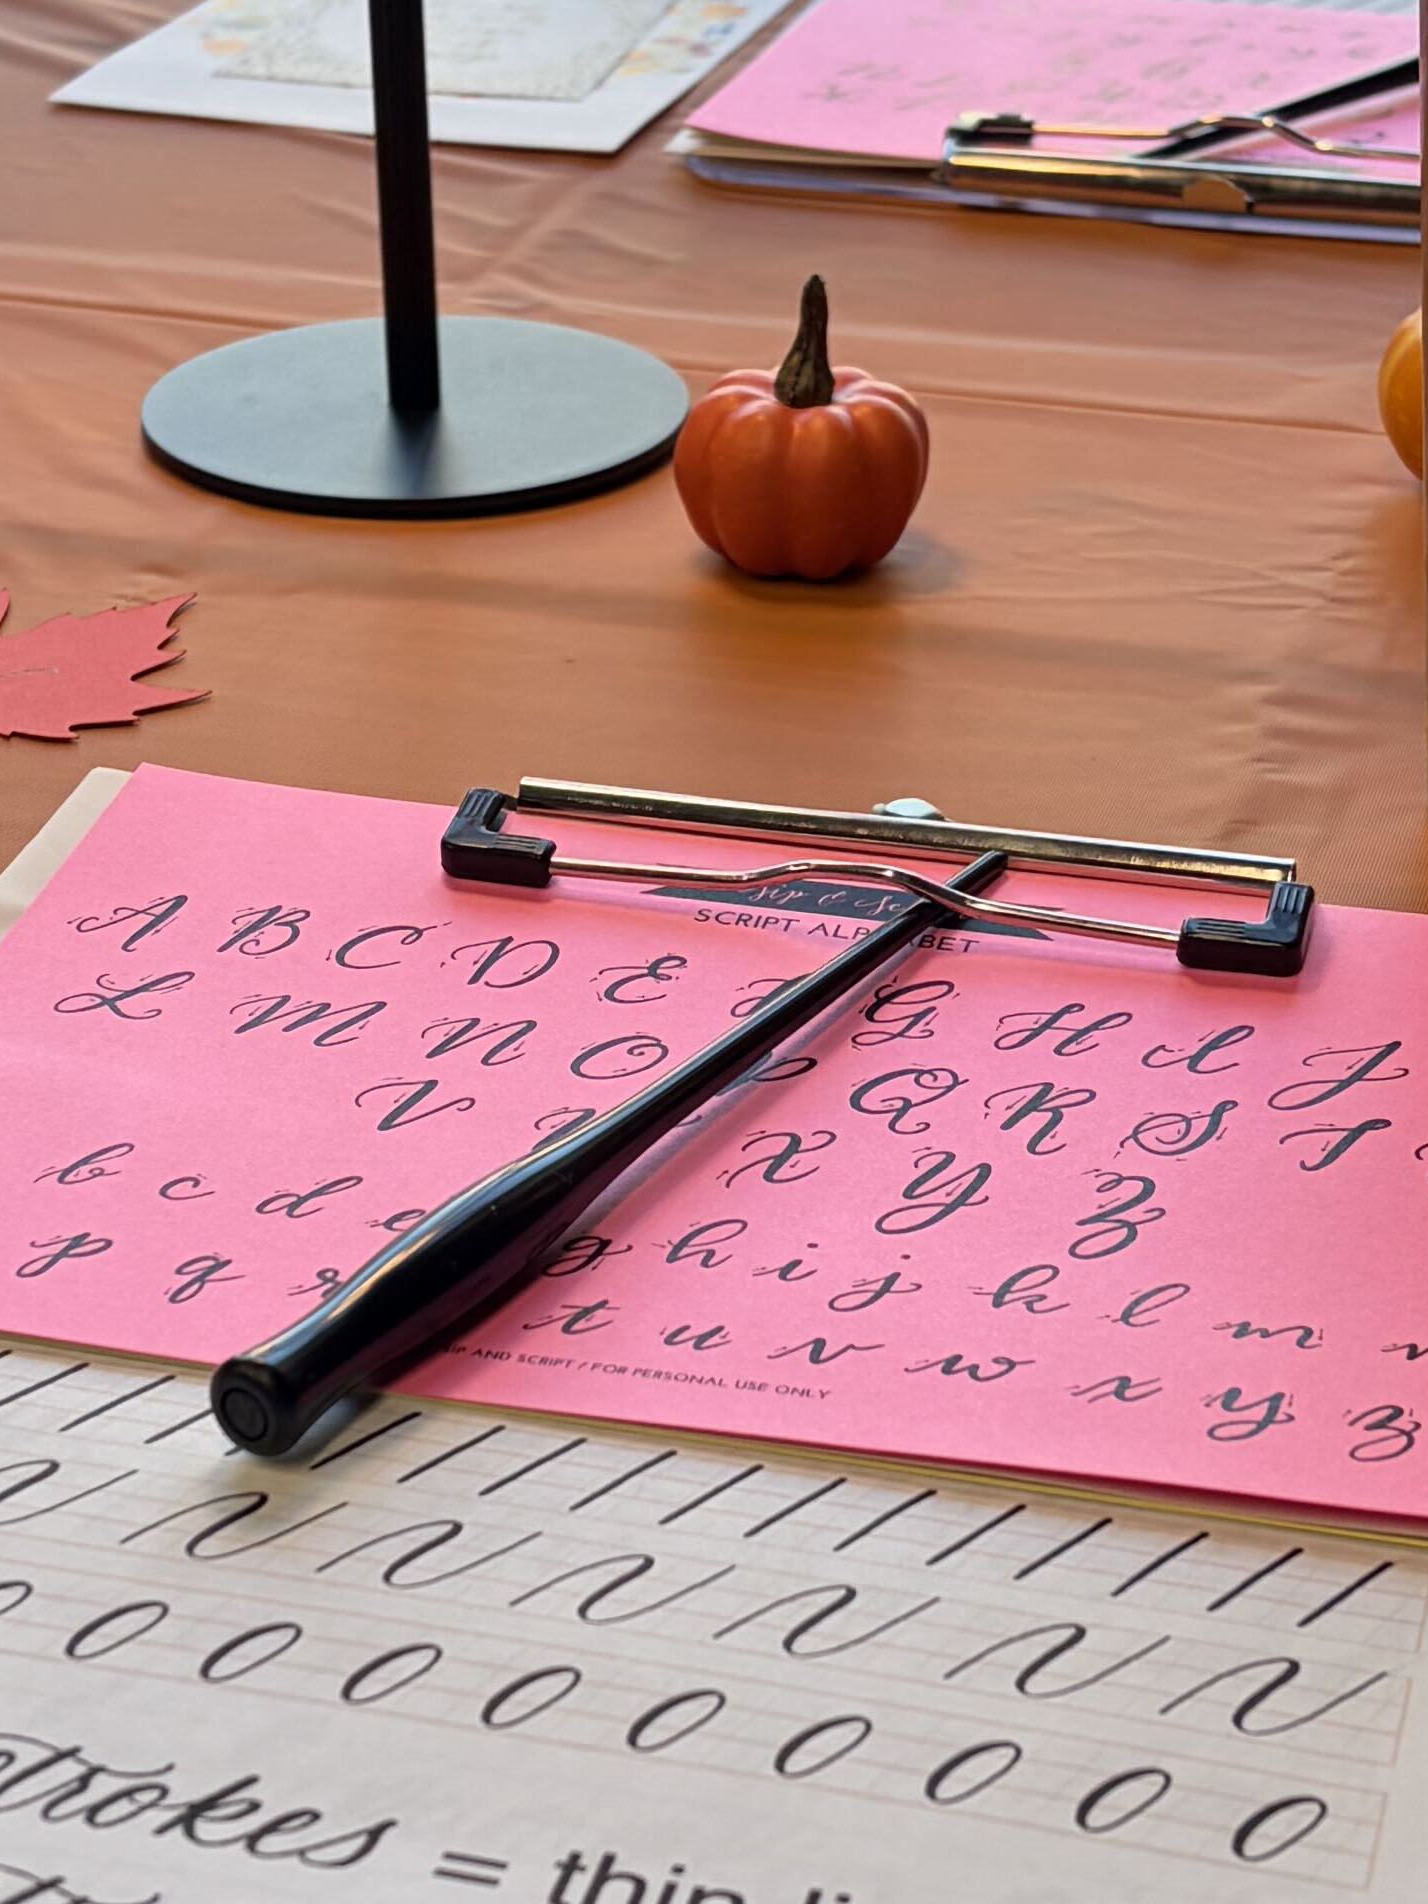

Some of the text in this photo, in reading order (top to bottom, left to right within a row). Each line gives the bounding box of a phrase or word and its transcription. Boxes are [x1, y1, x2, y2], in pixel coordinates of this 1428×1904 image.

[74, 895, 188, 953] A
[217, 904, 311, 956] B
[335, 925, 438, 970] C
[451, 935, 561, 989] D
[693, 907, 979, 954] SCRIPT ALPBET
[569, 1034, 670, 1080] O
[471, 1348, 511, 1361] AND
[517, 1353, 576, 1369] SCRIPT
[590, 1362, 629, 1376] FOR
[632, 1367, 729, 1388] PERSONAL
[735, 1379, 770, 1393] USE
[775, 1384, 832, 1400] ONLY
